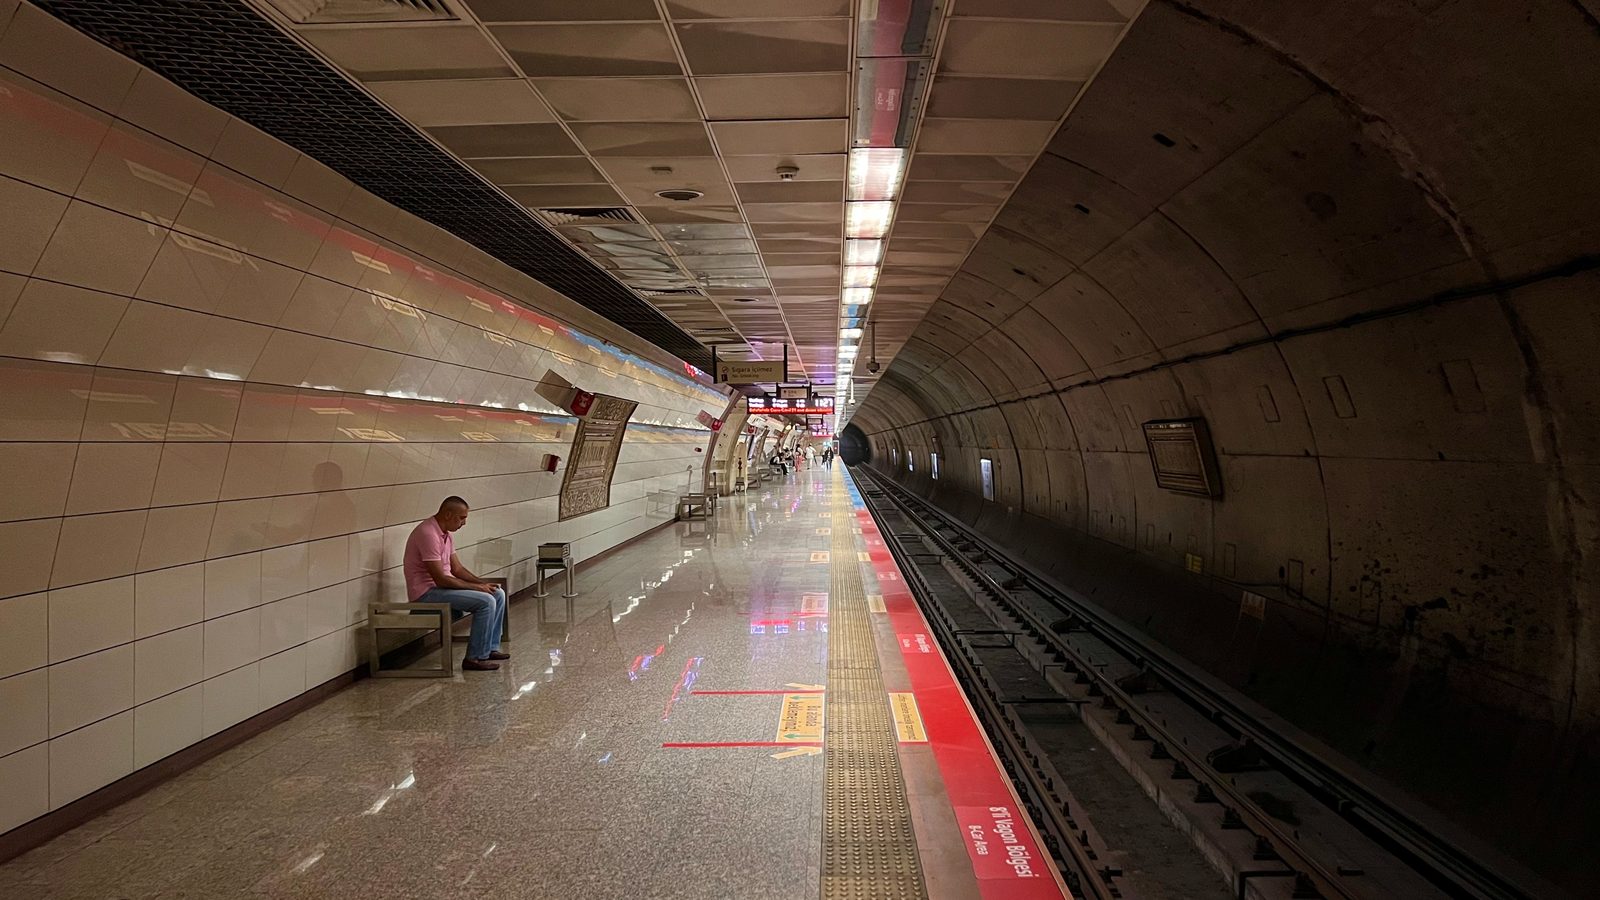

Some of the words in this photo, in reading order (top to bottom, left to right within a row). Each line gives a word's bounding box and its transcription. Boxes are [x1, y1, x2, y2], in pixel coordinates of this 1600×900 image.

[989, 806, 1012, 818] 8'li
[993, 819, 1018, 844] Vagon
[973, 840, 989, 855] Area
[1005, 845, 1040, 877] Bölgesi
